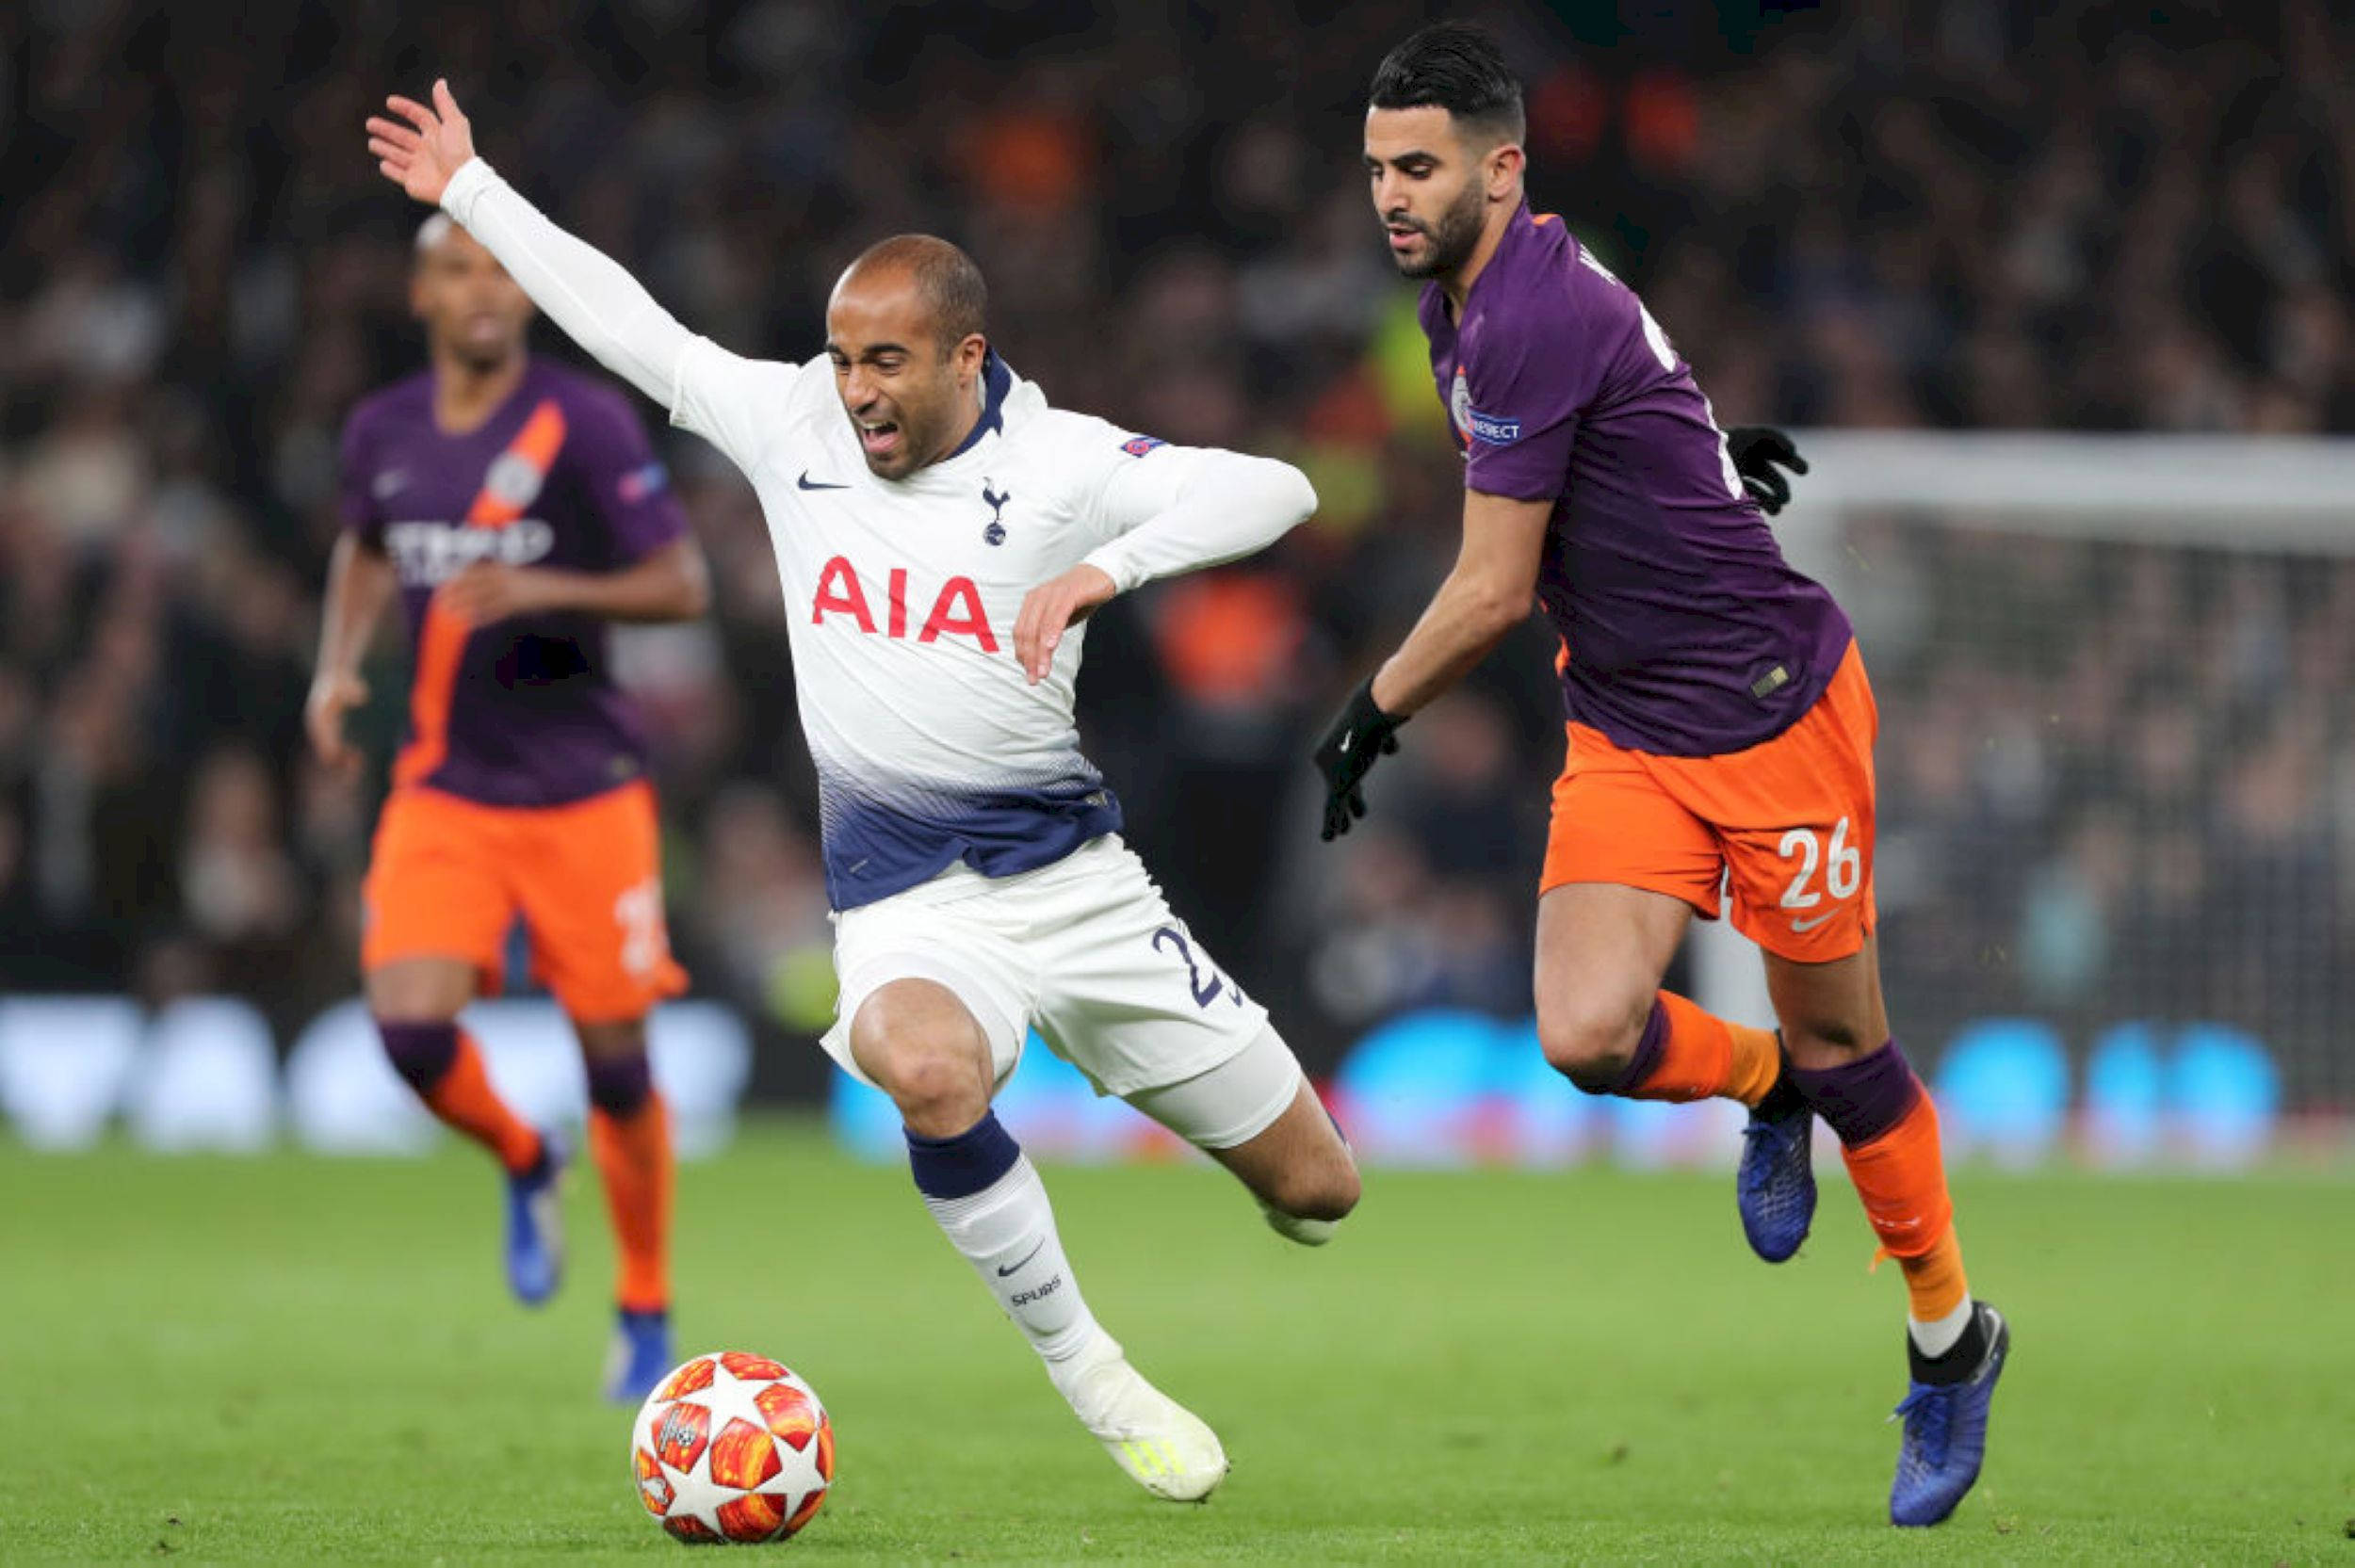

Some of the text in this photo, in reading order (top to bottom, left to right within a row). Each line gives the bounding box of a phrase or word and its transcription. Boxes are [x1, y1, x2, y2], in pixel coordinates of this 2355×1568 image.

[812, 554, 1000, 653] AIA
[1778, 816, 1861, 909] 26
[1011, 1273, 1063, 1307] SPURS
